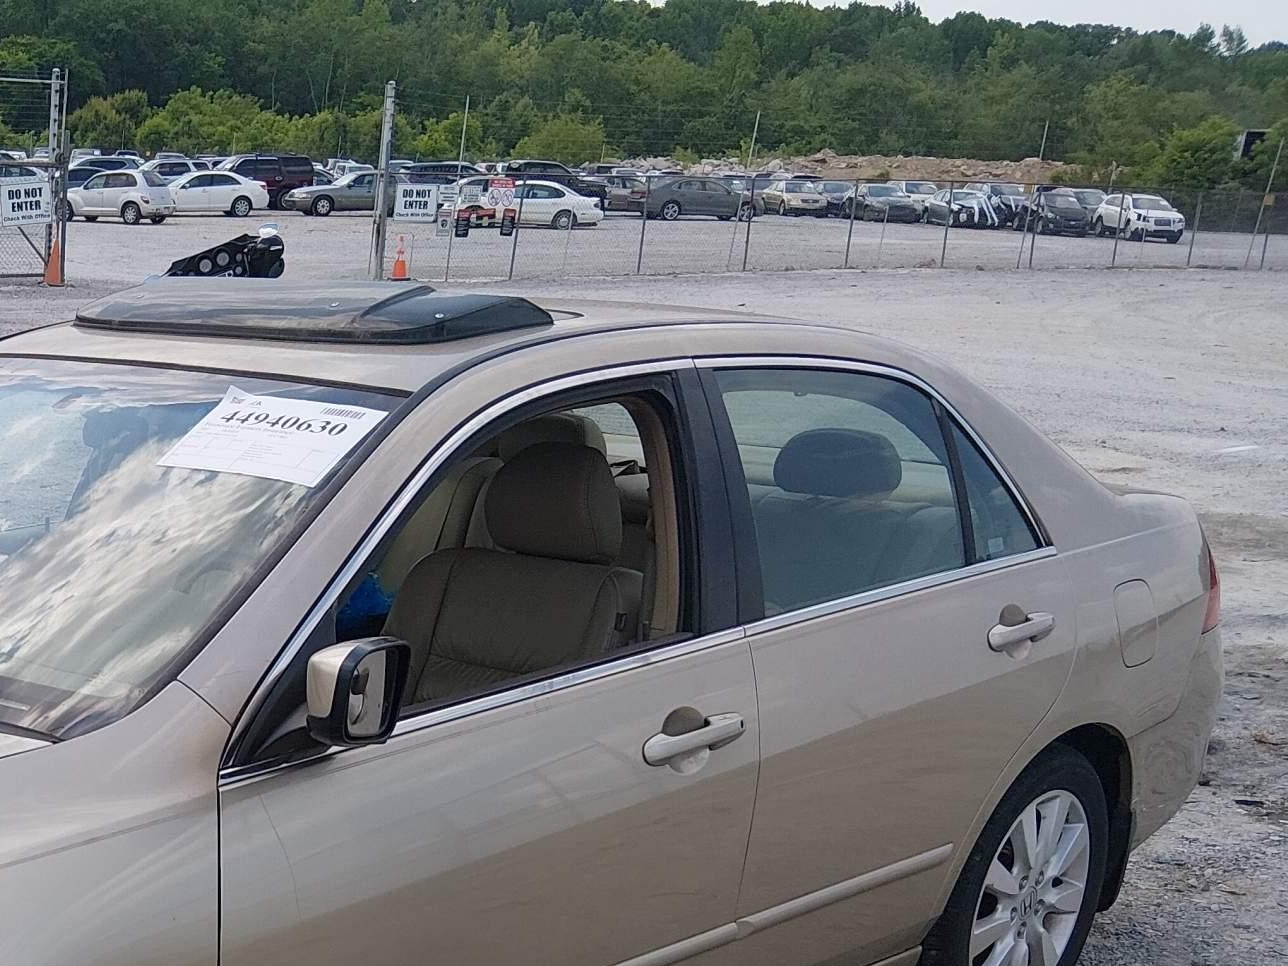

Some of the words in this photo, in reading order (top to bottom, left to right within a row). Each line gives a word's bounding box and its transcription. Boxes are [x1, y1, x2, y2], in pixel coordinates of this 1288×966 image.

[8, 189, 22, 200] DO
[24, 187, 43, 199] NOT
[402, 188, 414, 198] DO
[415, 188, 432, 198] NOT
[11, 200, 42, 213] ENTER
[403, 200, 429, 210] ENTER
[220, 410, 348, 437] 44940630
